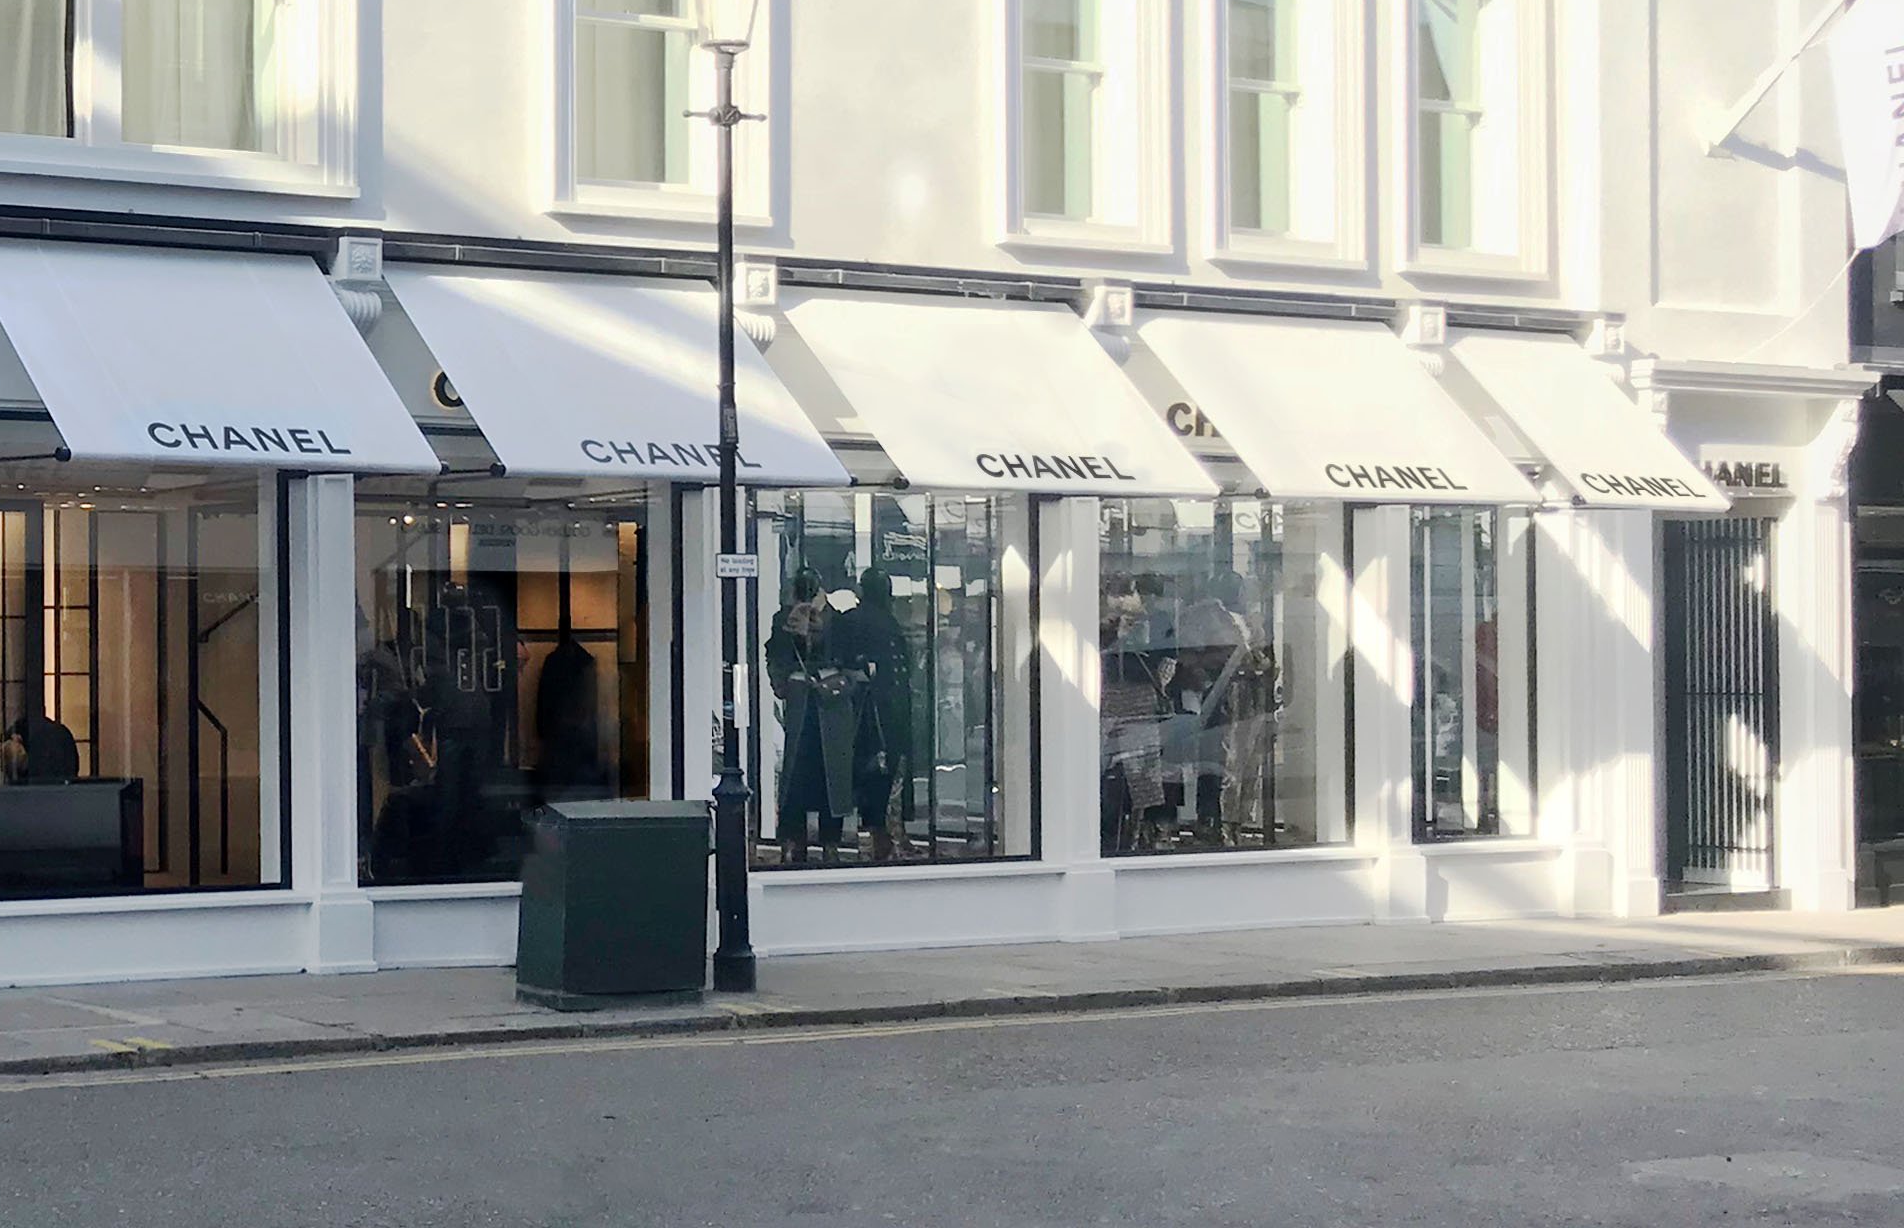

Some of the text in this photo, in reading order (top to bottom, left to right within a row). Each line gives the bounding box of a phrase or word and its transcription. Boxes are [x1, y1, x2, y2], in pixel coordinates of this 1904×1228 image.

[147, 422, 352, 454] CHANEL
[976, 454, 1137, 480] CHANEL
[1325, 463, 1469, 490] CHANEL
[1581, 472, 1707, 498] CHANEL
